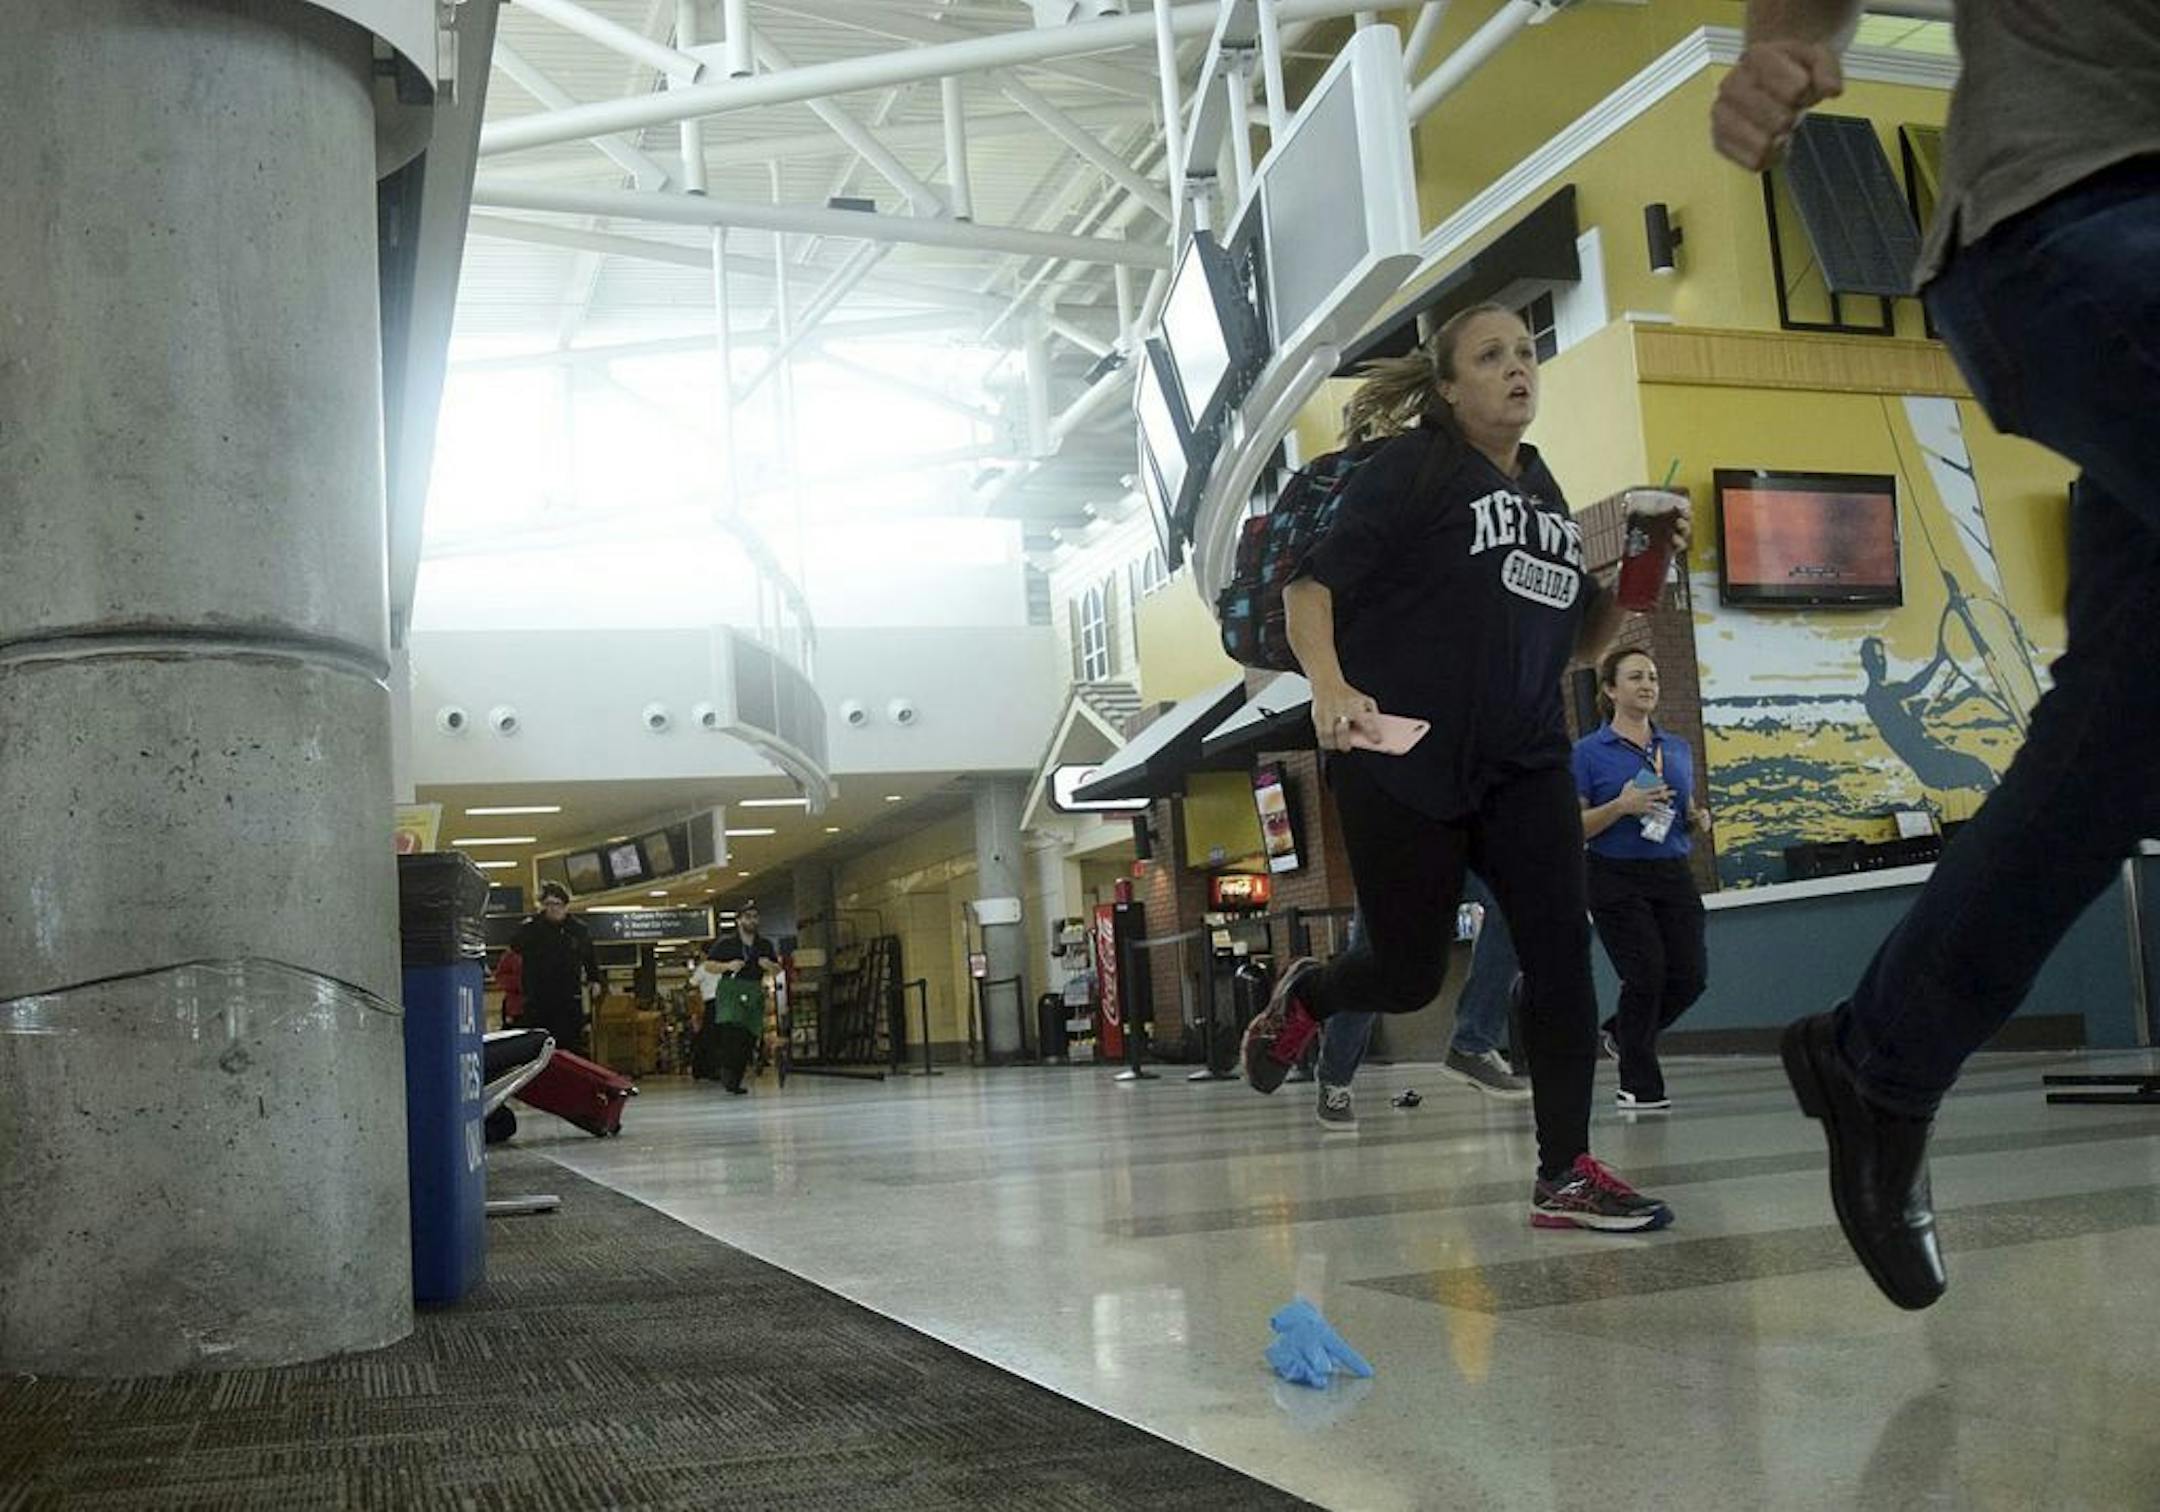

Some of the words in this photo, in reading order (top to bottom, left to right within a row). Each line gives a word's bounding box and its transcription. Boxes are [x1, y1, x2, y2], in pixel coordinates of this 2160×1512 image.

[1469, 489, 1528, 555] KEY
[1535, 509, 1588, 574] WE
[1508, 556, 1574, 604] FLORIDA
